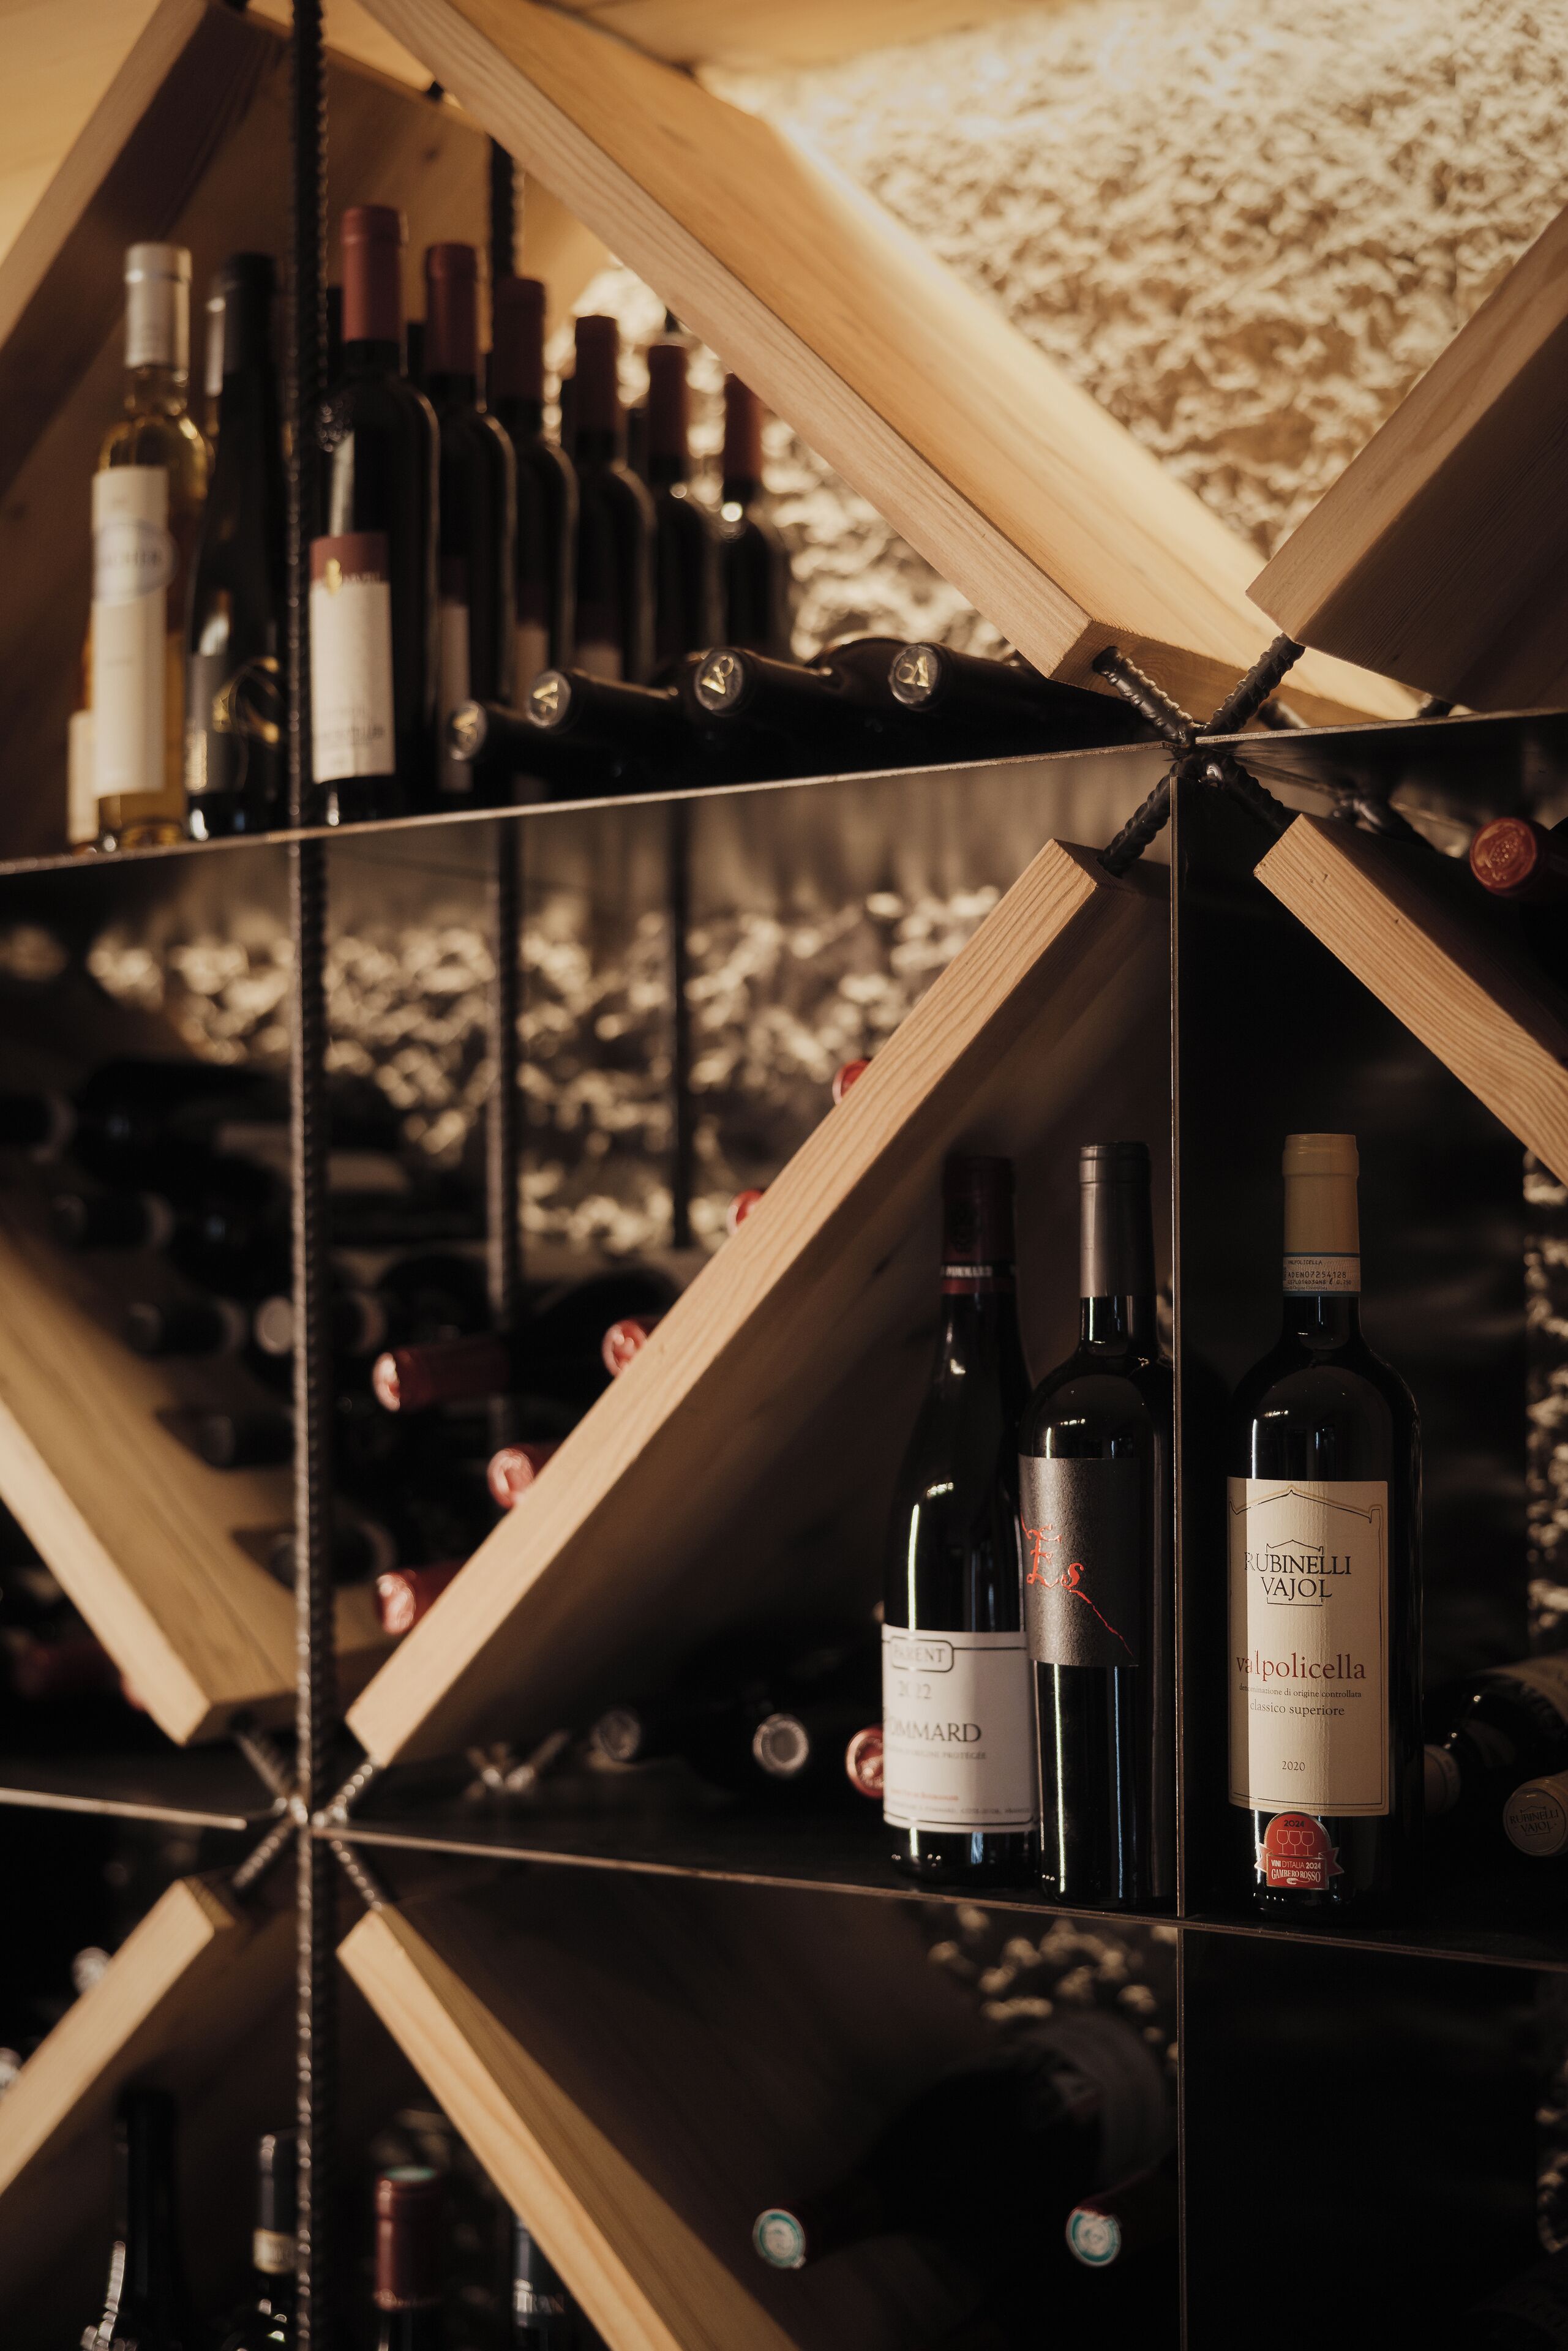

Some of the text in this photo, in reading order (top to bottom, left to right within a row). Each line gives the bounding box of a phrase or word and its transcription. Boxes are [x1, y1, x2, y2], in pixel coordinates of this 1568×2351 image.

[1244, 1551, 1352, 1575] RUBINELLI
[1260, 1577, 1333, 1601] VAJOL
[1236, 1649, 1367, 1682] valpolicella
[1239, 1682, 1362, 1700] denominazione di origine controllata
[1249, 1698, 1345, 1717] classico superiore
[887, 1714, 982, 1742] OMMARD
[1281, 1760, 1305, 1772] 2020
[1509, 1809, 1559, 1824] RUBINELLI
[1520, 1820, 1553, 1833] VAJOL
[1282, 1860, 1305, 1869] D'ITALIA
[1271, 1868, 1321, 1883] GAMBERO ROSSO
